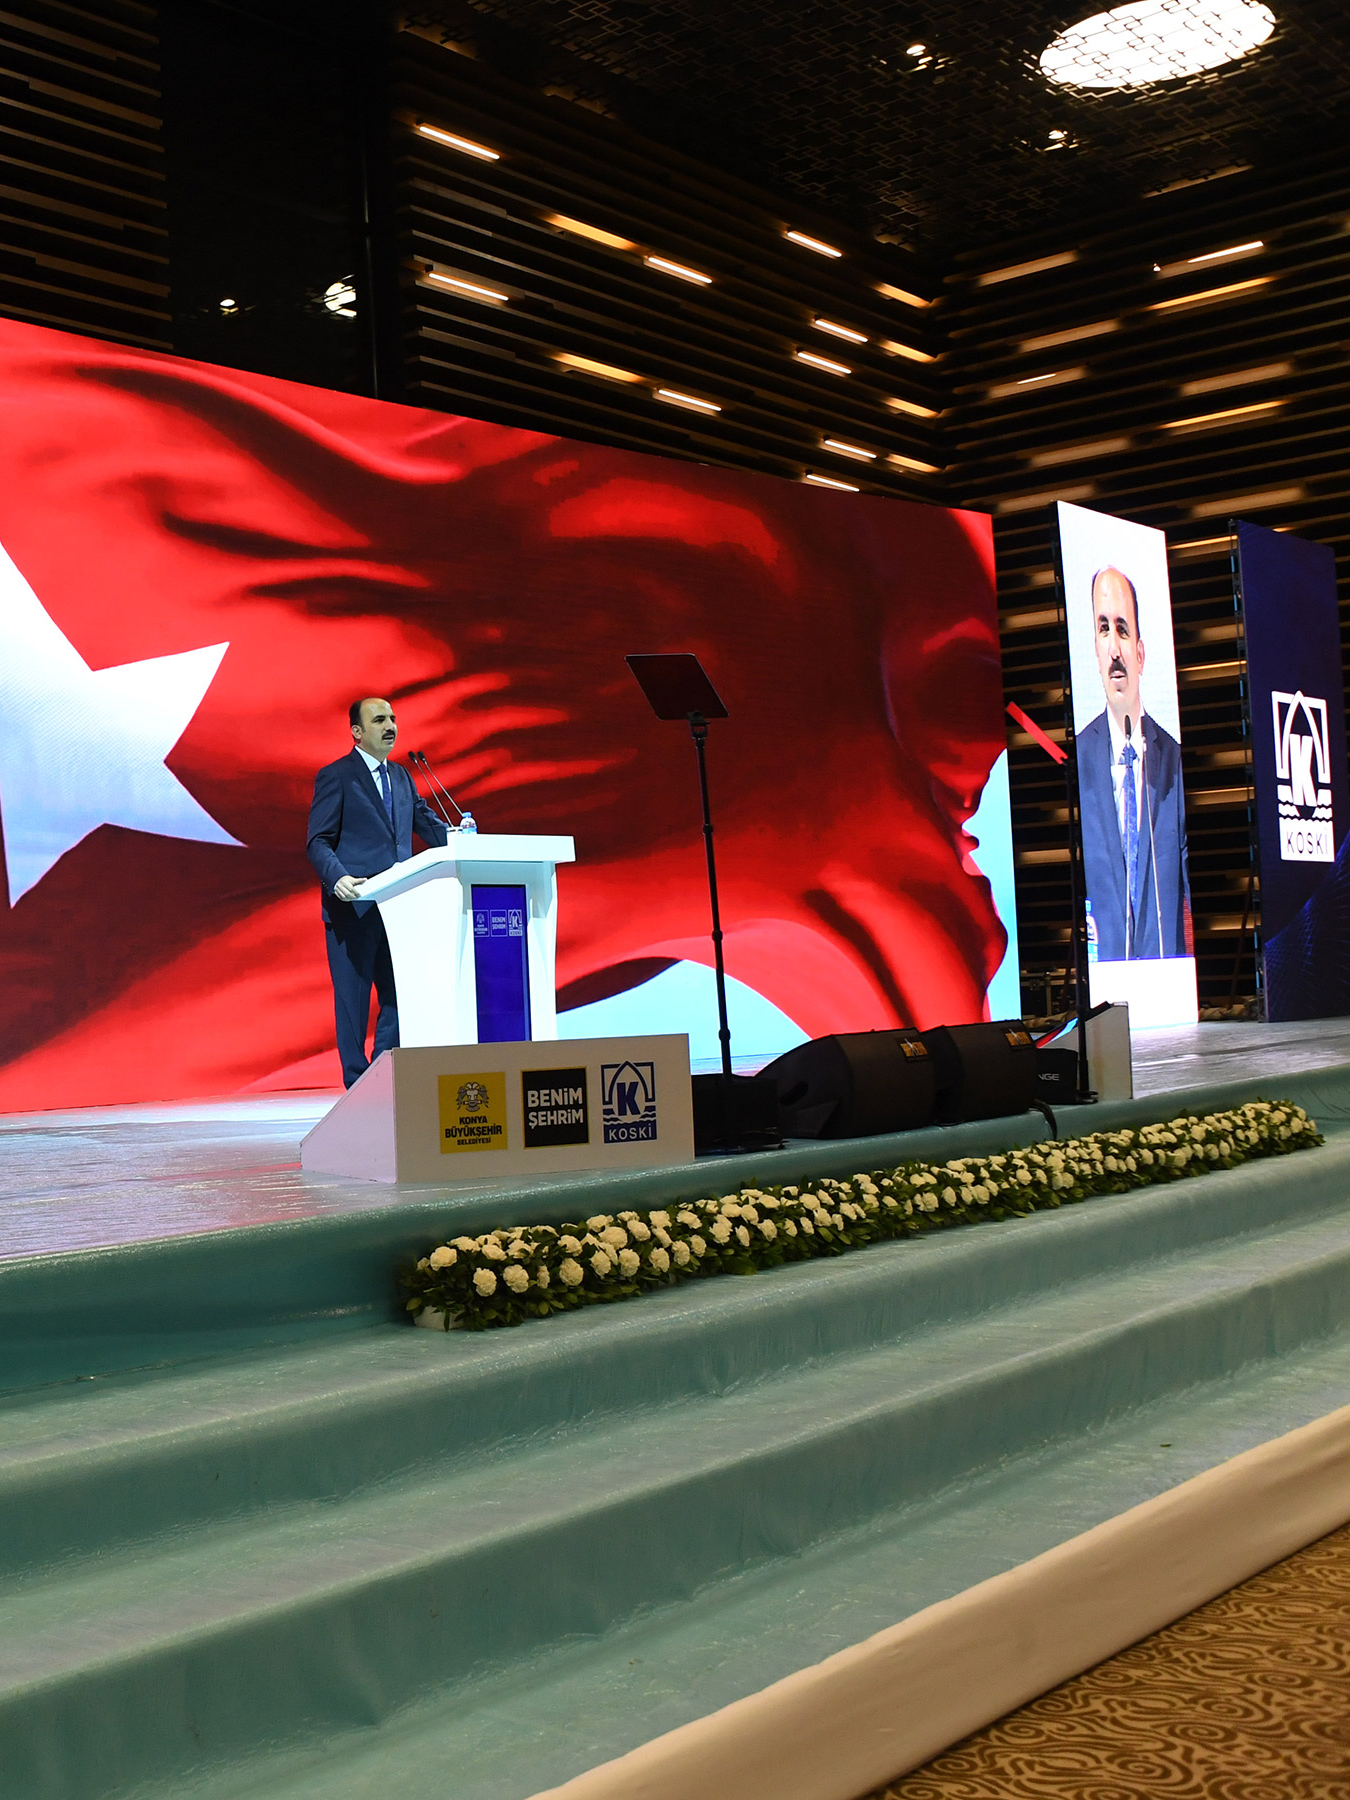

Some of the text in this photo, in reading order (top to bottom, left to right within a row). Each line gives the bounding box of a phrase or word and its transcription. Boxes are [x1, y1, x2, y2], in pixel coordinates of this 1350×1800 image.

[459, 1115, 488, 1125] KONYA
[445, 1123, 502, 1138] BÜYÜKŞEHİR
[608, 1123, 652, 1140] KOSKİ
